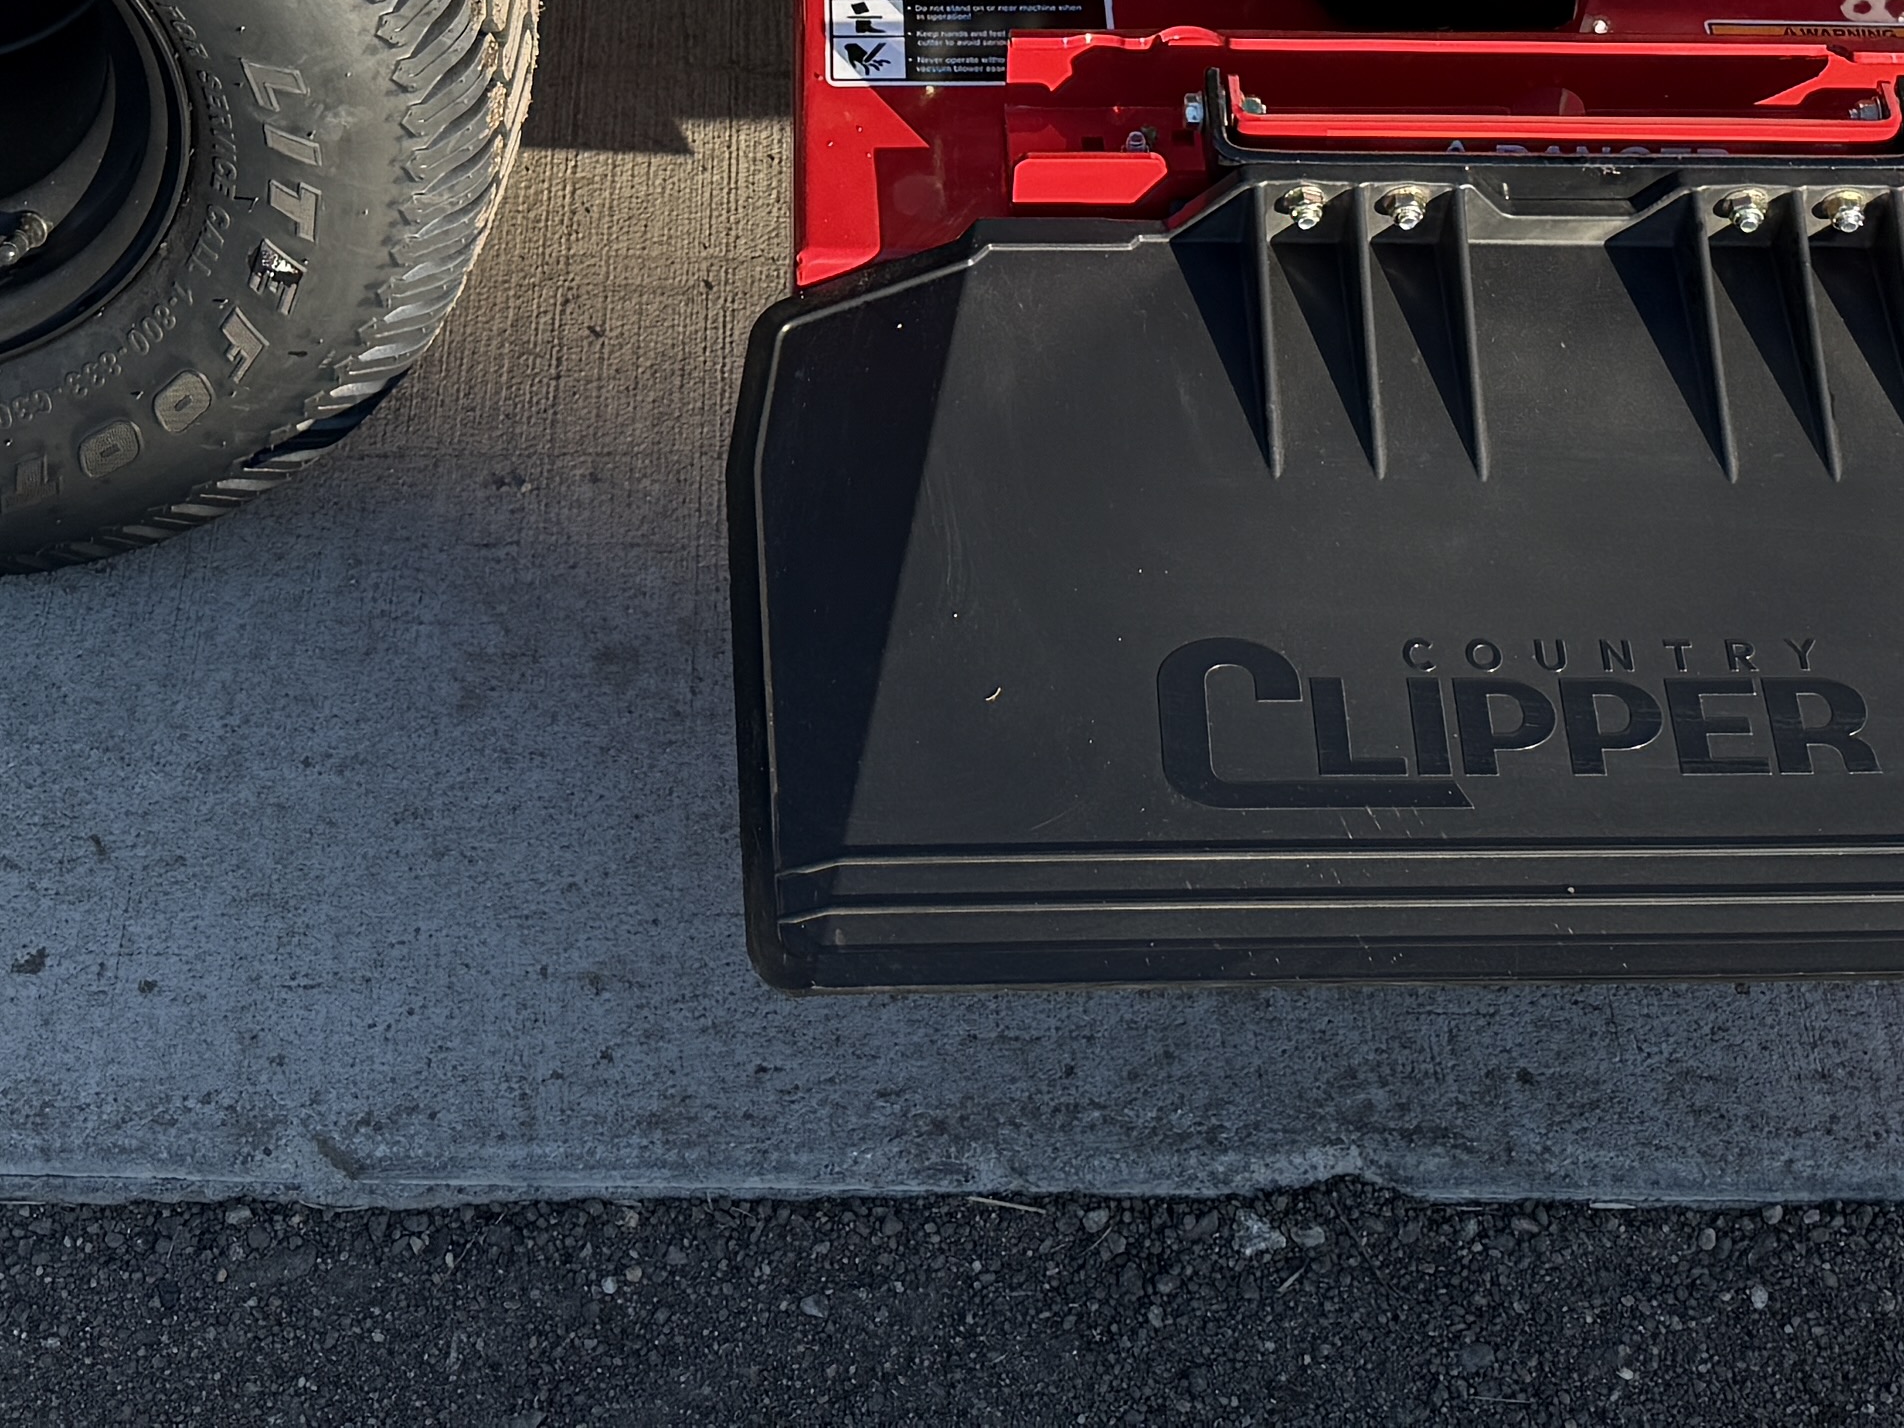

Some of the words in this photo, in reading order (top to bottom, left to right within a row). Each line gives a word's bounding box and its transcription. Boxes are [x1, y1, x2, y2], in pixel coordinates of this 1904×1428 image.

[156, 2, 209, 60] FOR
[197, 68, 237, 200] SERVICE
[188, 203, 232, 278] CALL
[1402, 638, 1817, 673] COUNTRY
[1156, 636, 1884, 812] CLIPPER
